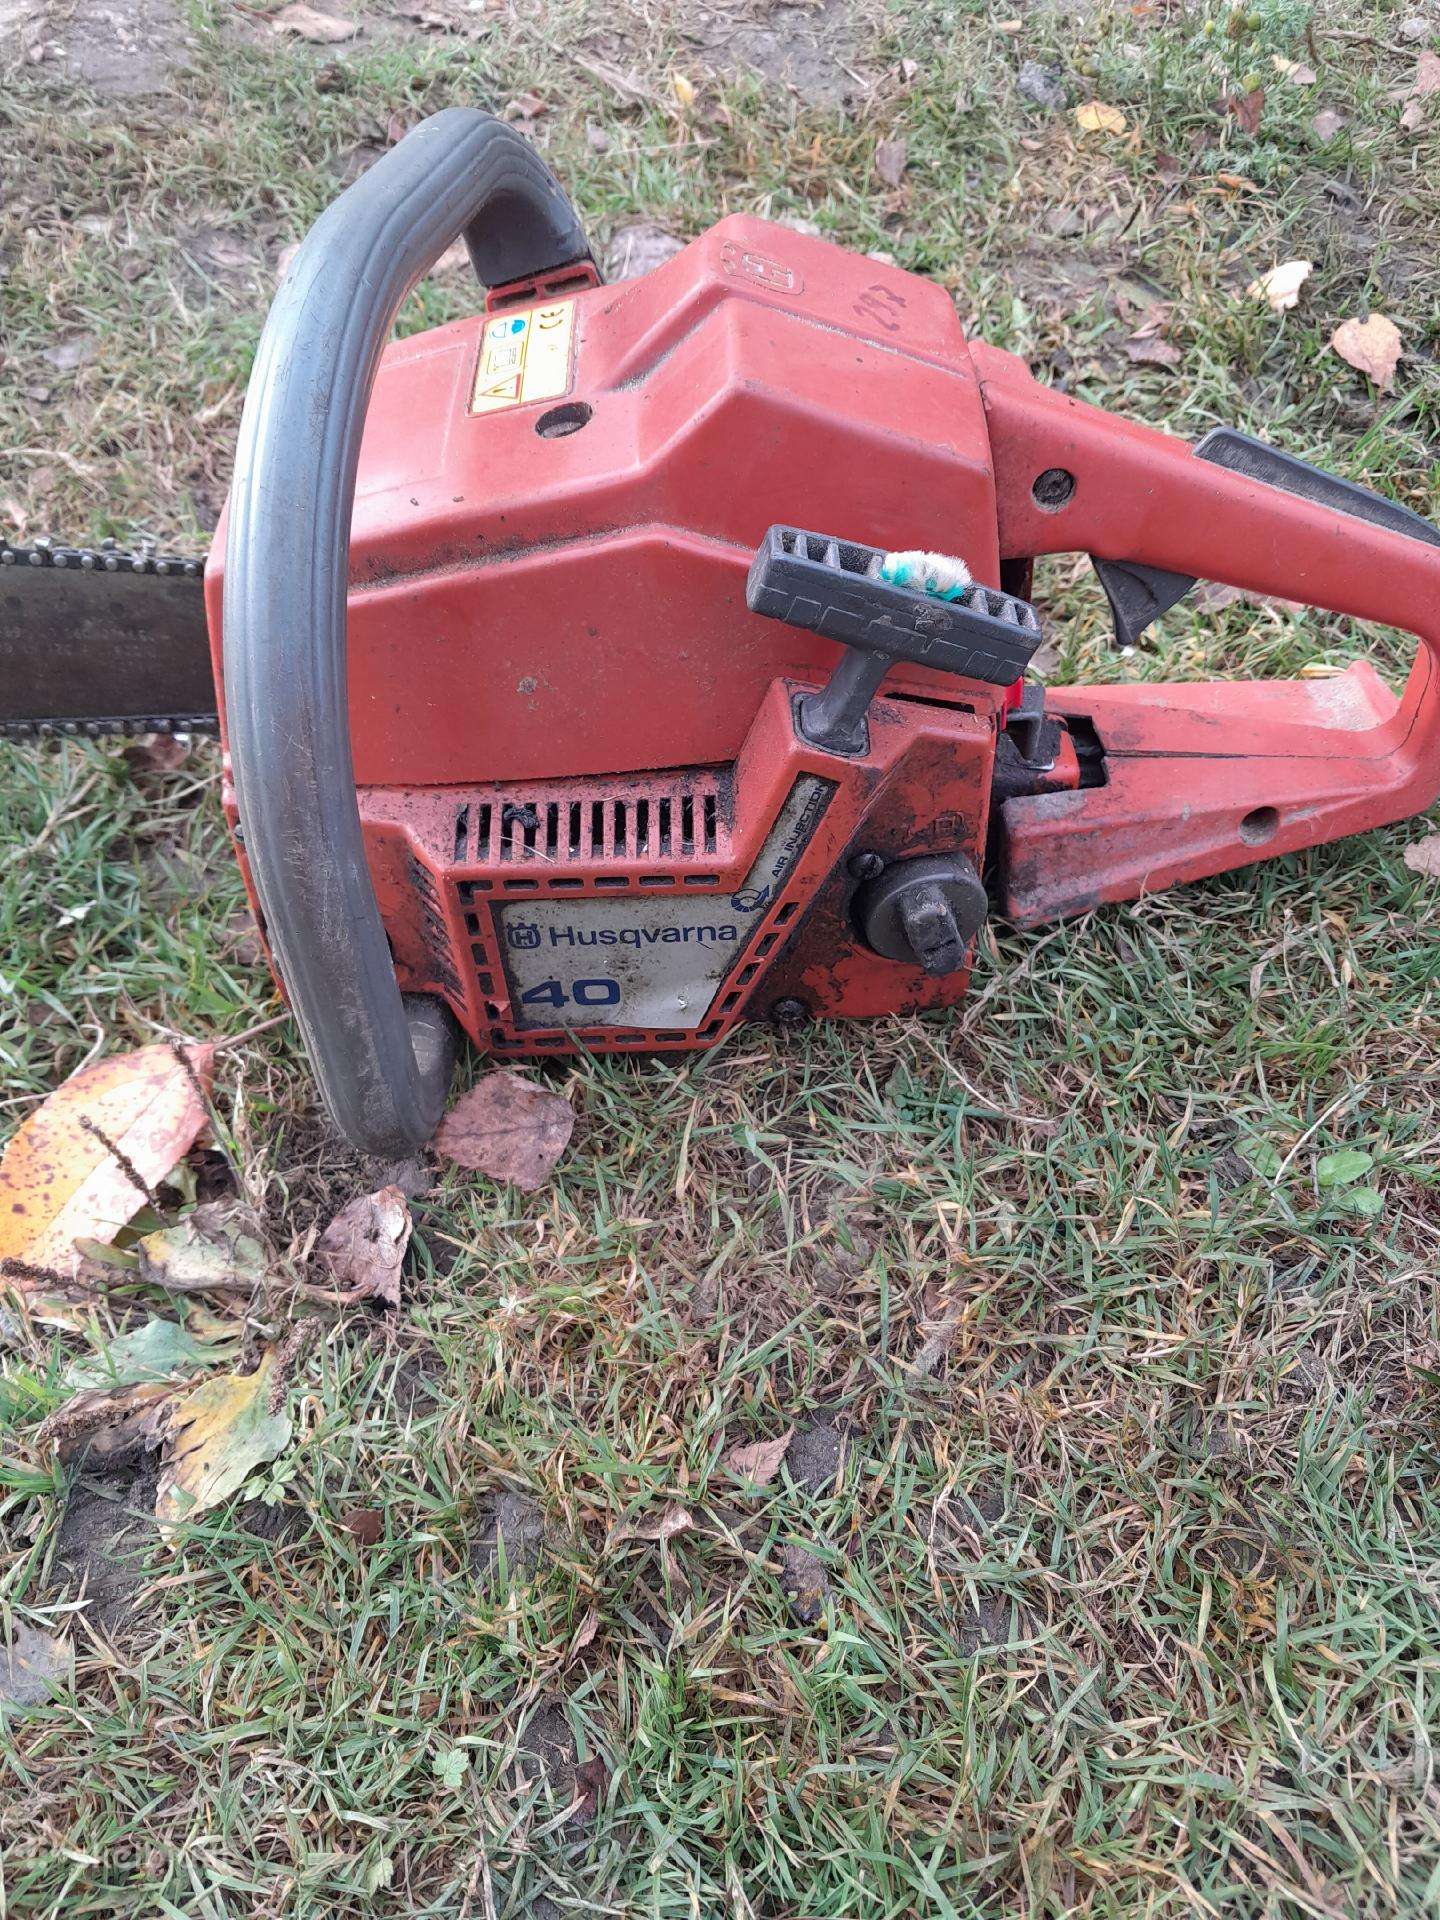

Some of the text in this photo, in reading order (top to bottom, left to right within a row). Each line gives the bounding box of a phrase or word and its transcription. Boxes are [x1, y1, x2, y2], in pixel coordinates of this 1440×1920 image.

[771, 856, 789, 878] AIR
[549, 924, 738, 949] Husqvarna
[521, 978, 621, 1009] 40
